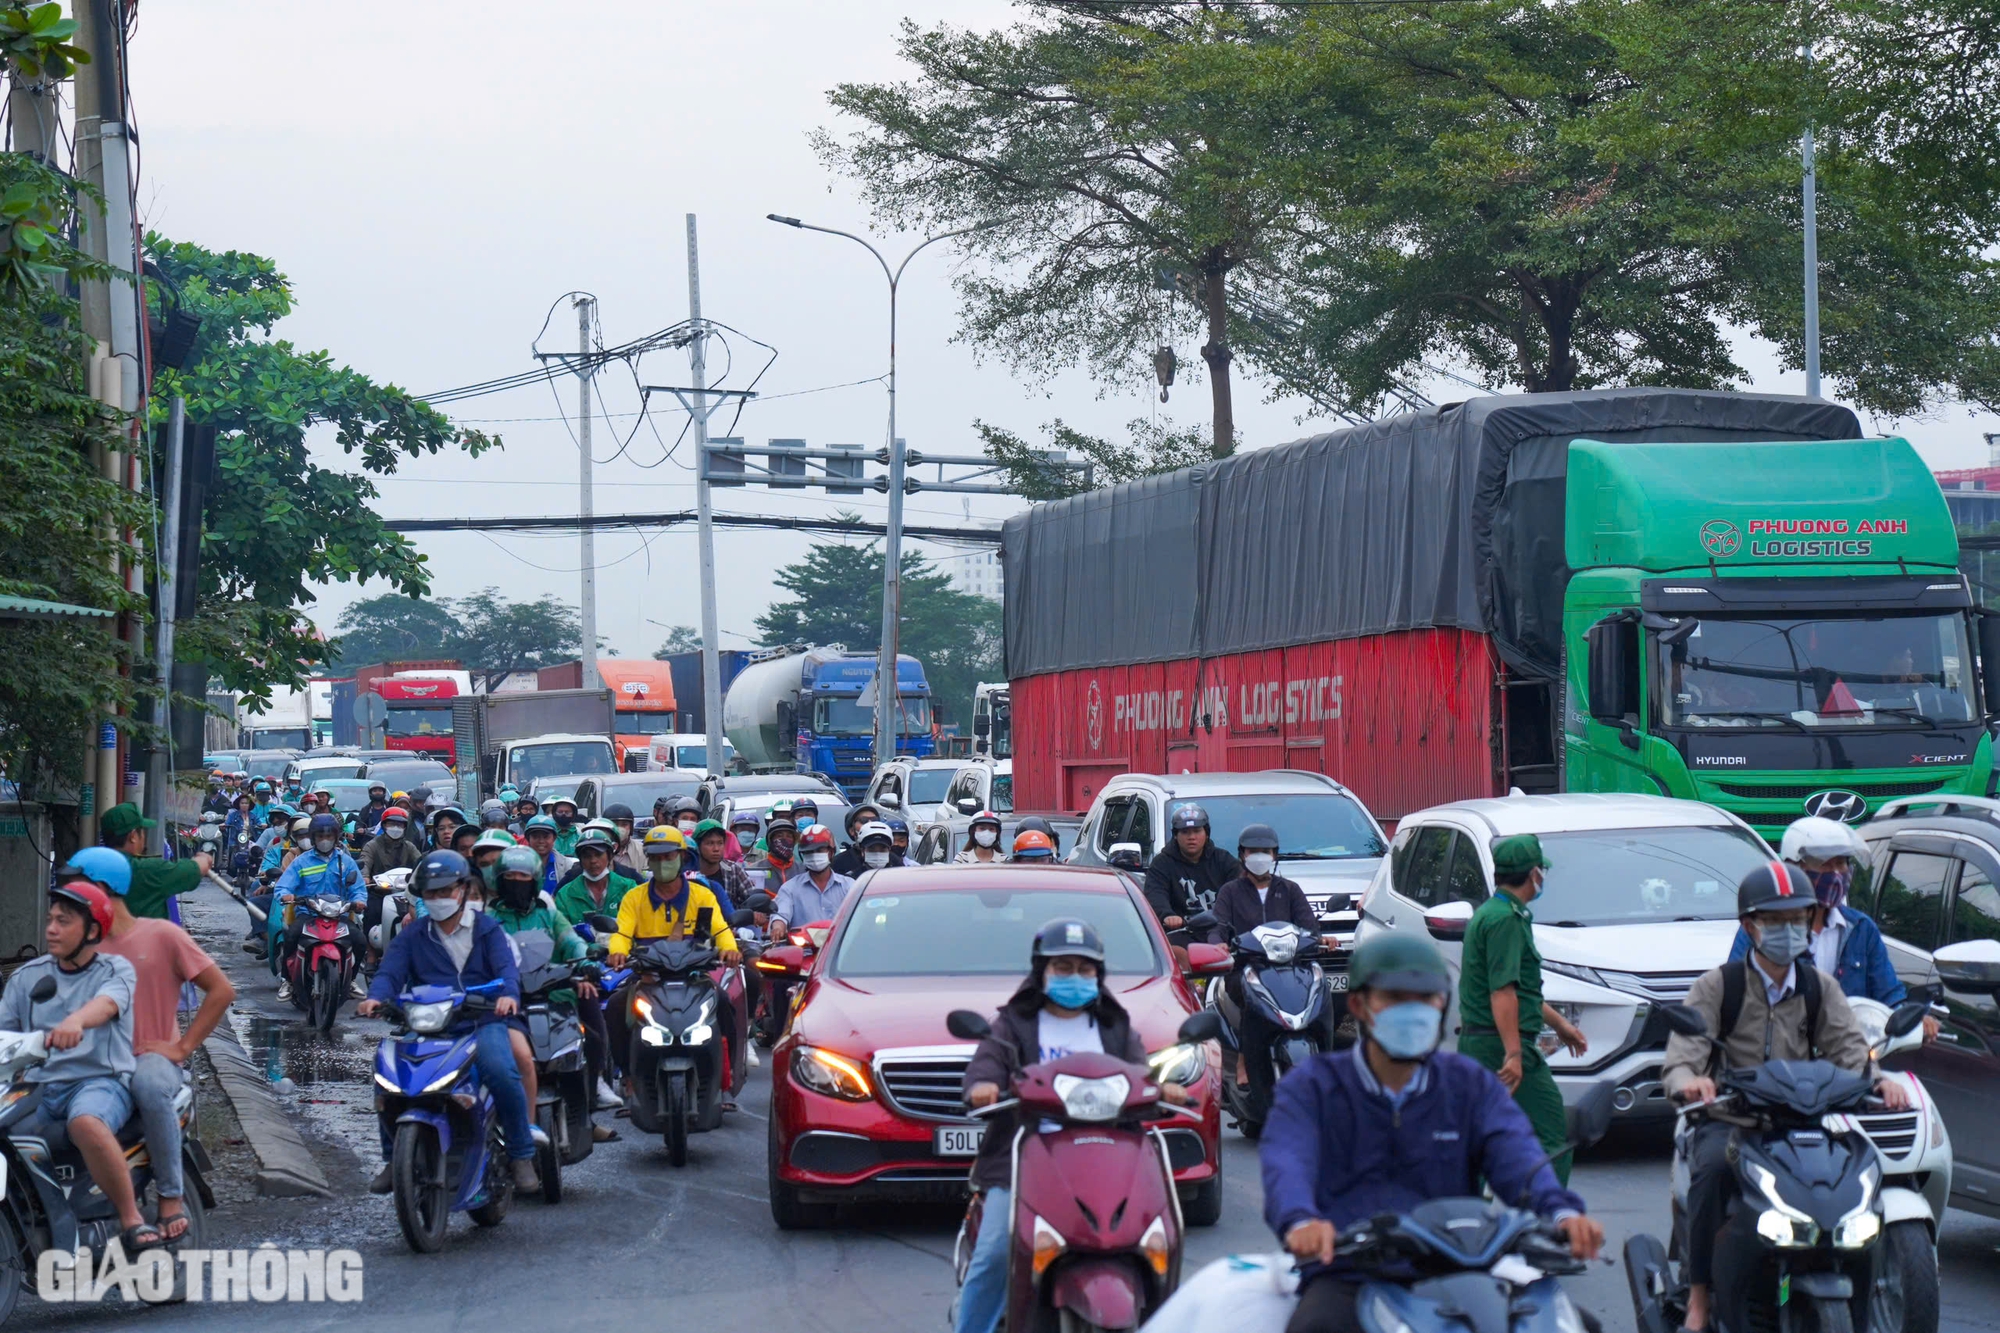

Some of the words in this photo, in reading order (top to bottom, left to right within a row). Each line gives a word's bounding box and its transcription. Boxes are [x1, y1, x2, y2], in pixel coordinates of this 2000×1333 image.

[1748, 518, 1848, 534] PHUONG
[1855, 518, 1907, 534] ANH
[1751, 539, 1872, 557] LOGISTICS
[1114, 690, 1183, 733] PHUONG
[1241, 675, 1342, 726] LOGISTICS
[1696, 756, 1746, 765] HYUNDAI
[1908, 754, 1968, 764] XCIENT
